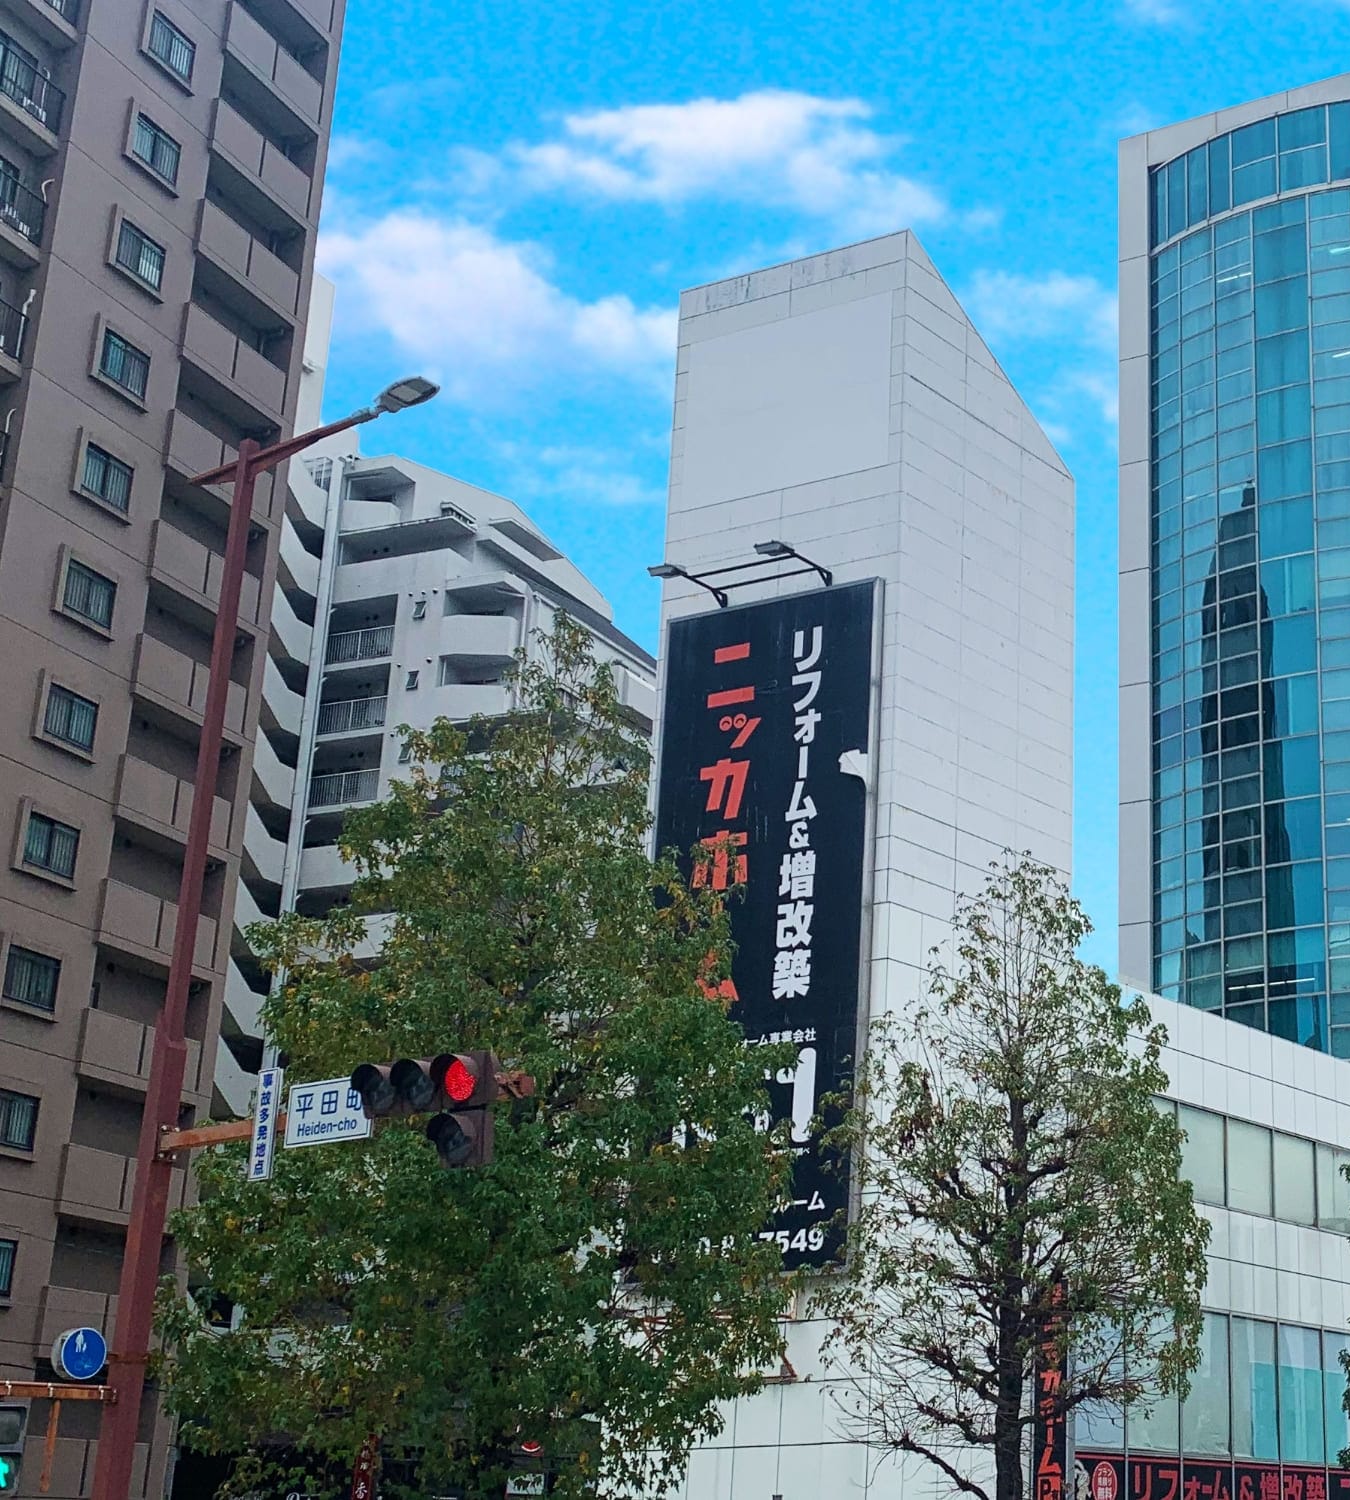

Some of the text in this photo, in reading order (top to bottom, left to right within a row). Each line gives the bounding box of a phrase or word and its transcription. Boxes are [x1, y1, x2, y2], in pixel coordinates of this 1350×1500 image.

[772, 626, 823, 1000] リフォーム&増改築
[295, 1087, 362, 1119] 平田町
[296, 1117, 358, 1137] Heiden-cho
